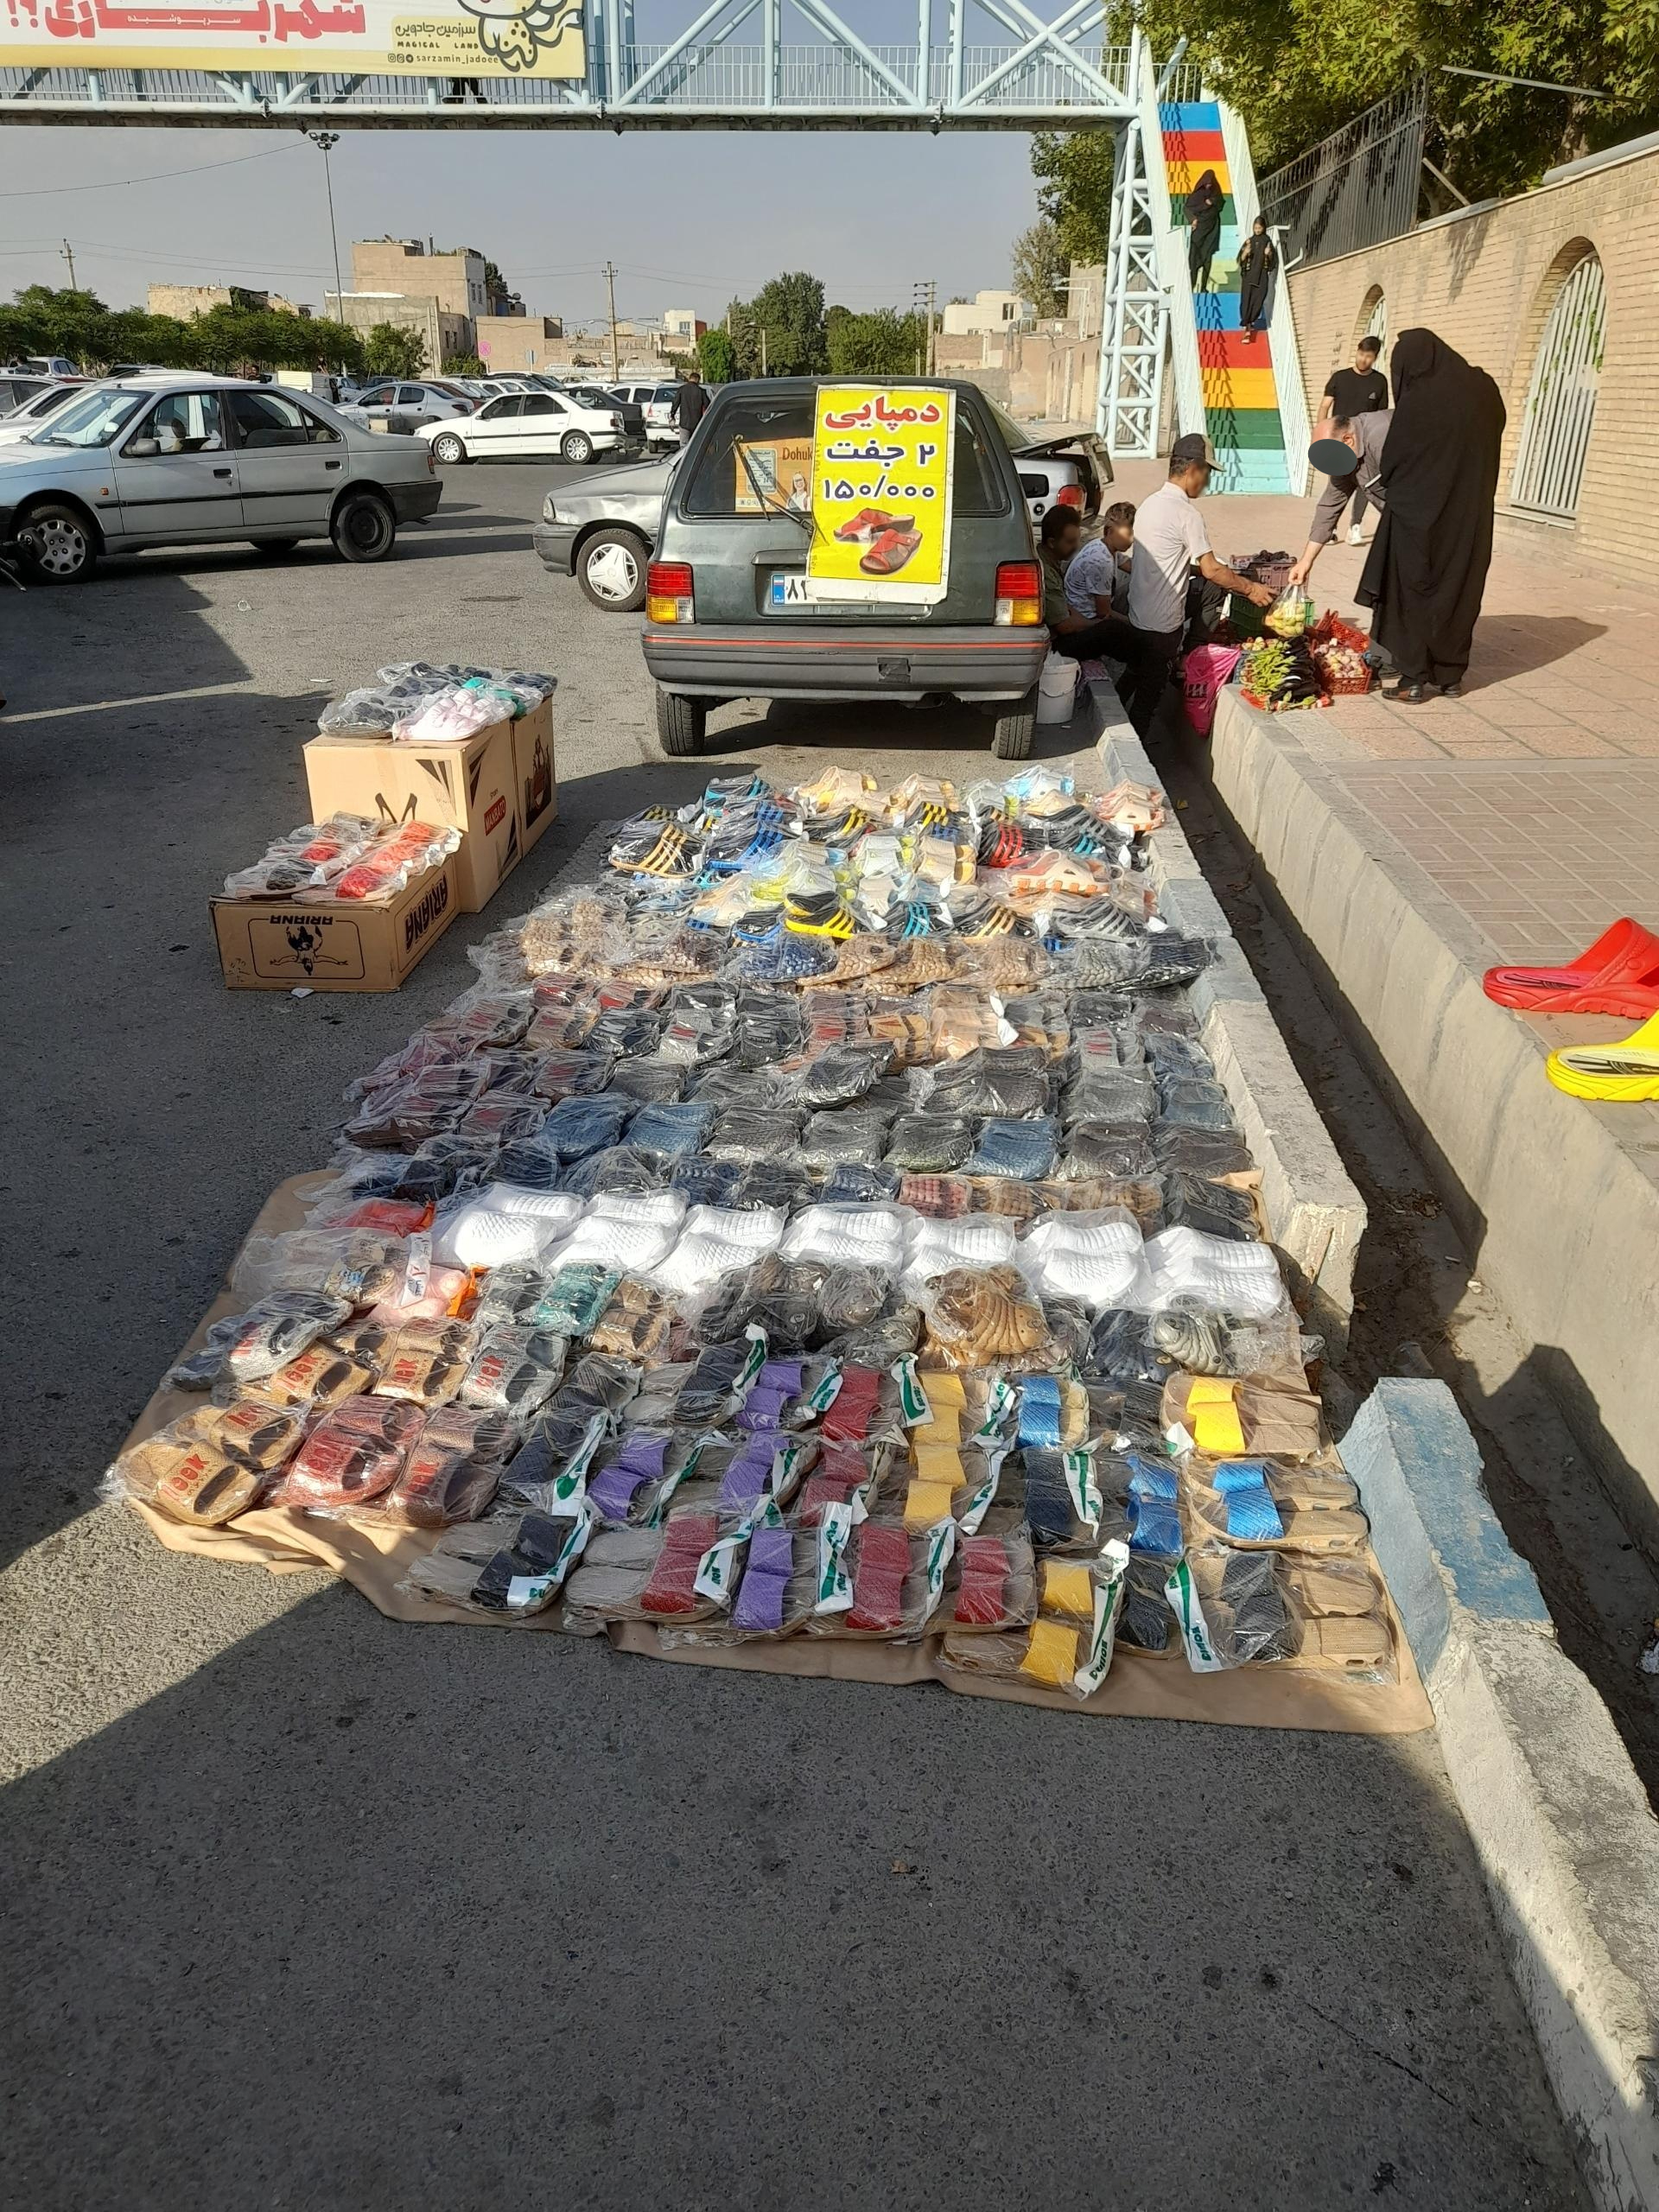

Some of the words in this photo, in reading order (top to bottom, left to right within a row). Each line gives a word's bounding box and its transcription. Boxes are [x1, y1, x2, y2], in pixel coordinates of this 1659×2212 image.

[436, 22, 476, 37] سرزمین
[826, 396, 940, 430] دمپایی
[782, 447, 813, 461] Dohuk
[827, 440, 905, 467] جفت
[919, 444, 935, 465] ۲
[270, 914, 334, 925] ARIANA
[404, 873, 448, 952] ARIANA
